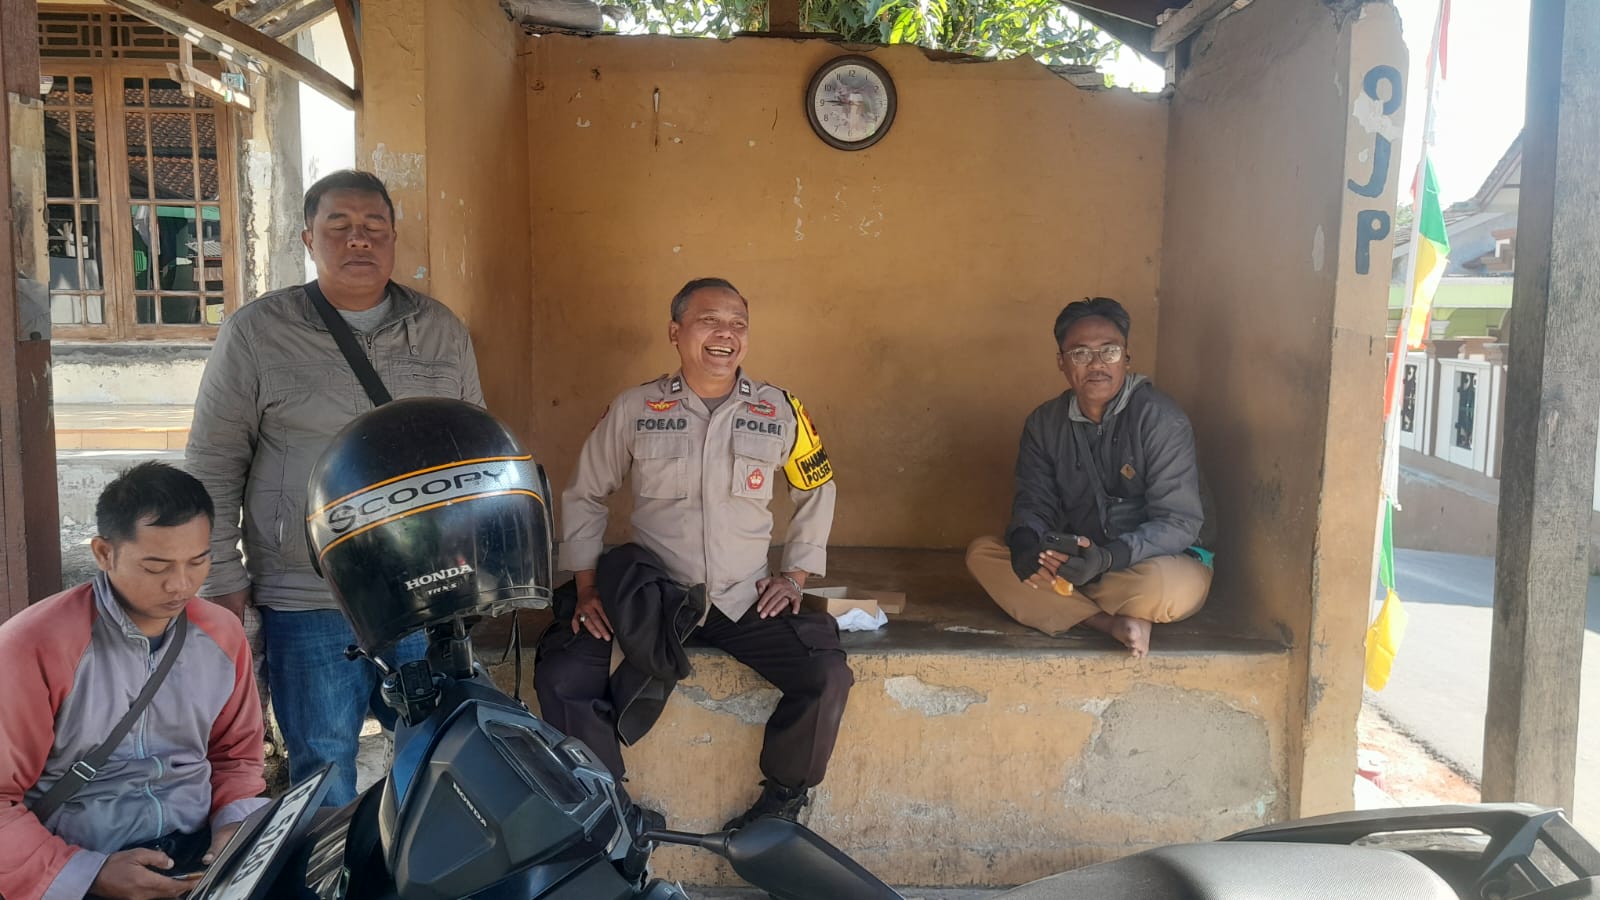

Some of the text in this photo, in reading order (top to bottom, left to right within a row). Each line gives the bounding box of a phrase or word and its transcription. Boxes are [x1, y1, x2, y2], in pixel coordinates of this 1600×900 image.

[848, 69, 856, 78] 12
[824, 84, 832, 92] 10
[636, 417, 688, 432] FOEAD
[735, 417, 782, 437] POLRI
[328, 469, 503, 533] SCOOPY
[405, 564, 474, 591] HONDA
[280, 784, 313, 811] R
[453, 780, 488, 828] HONDA
